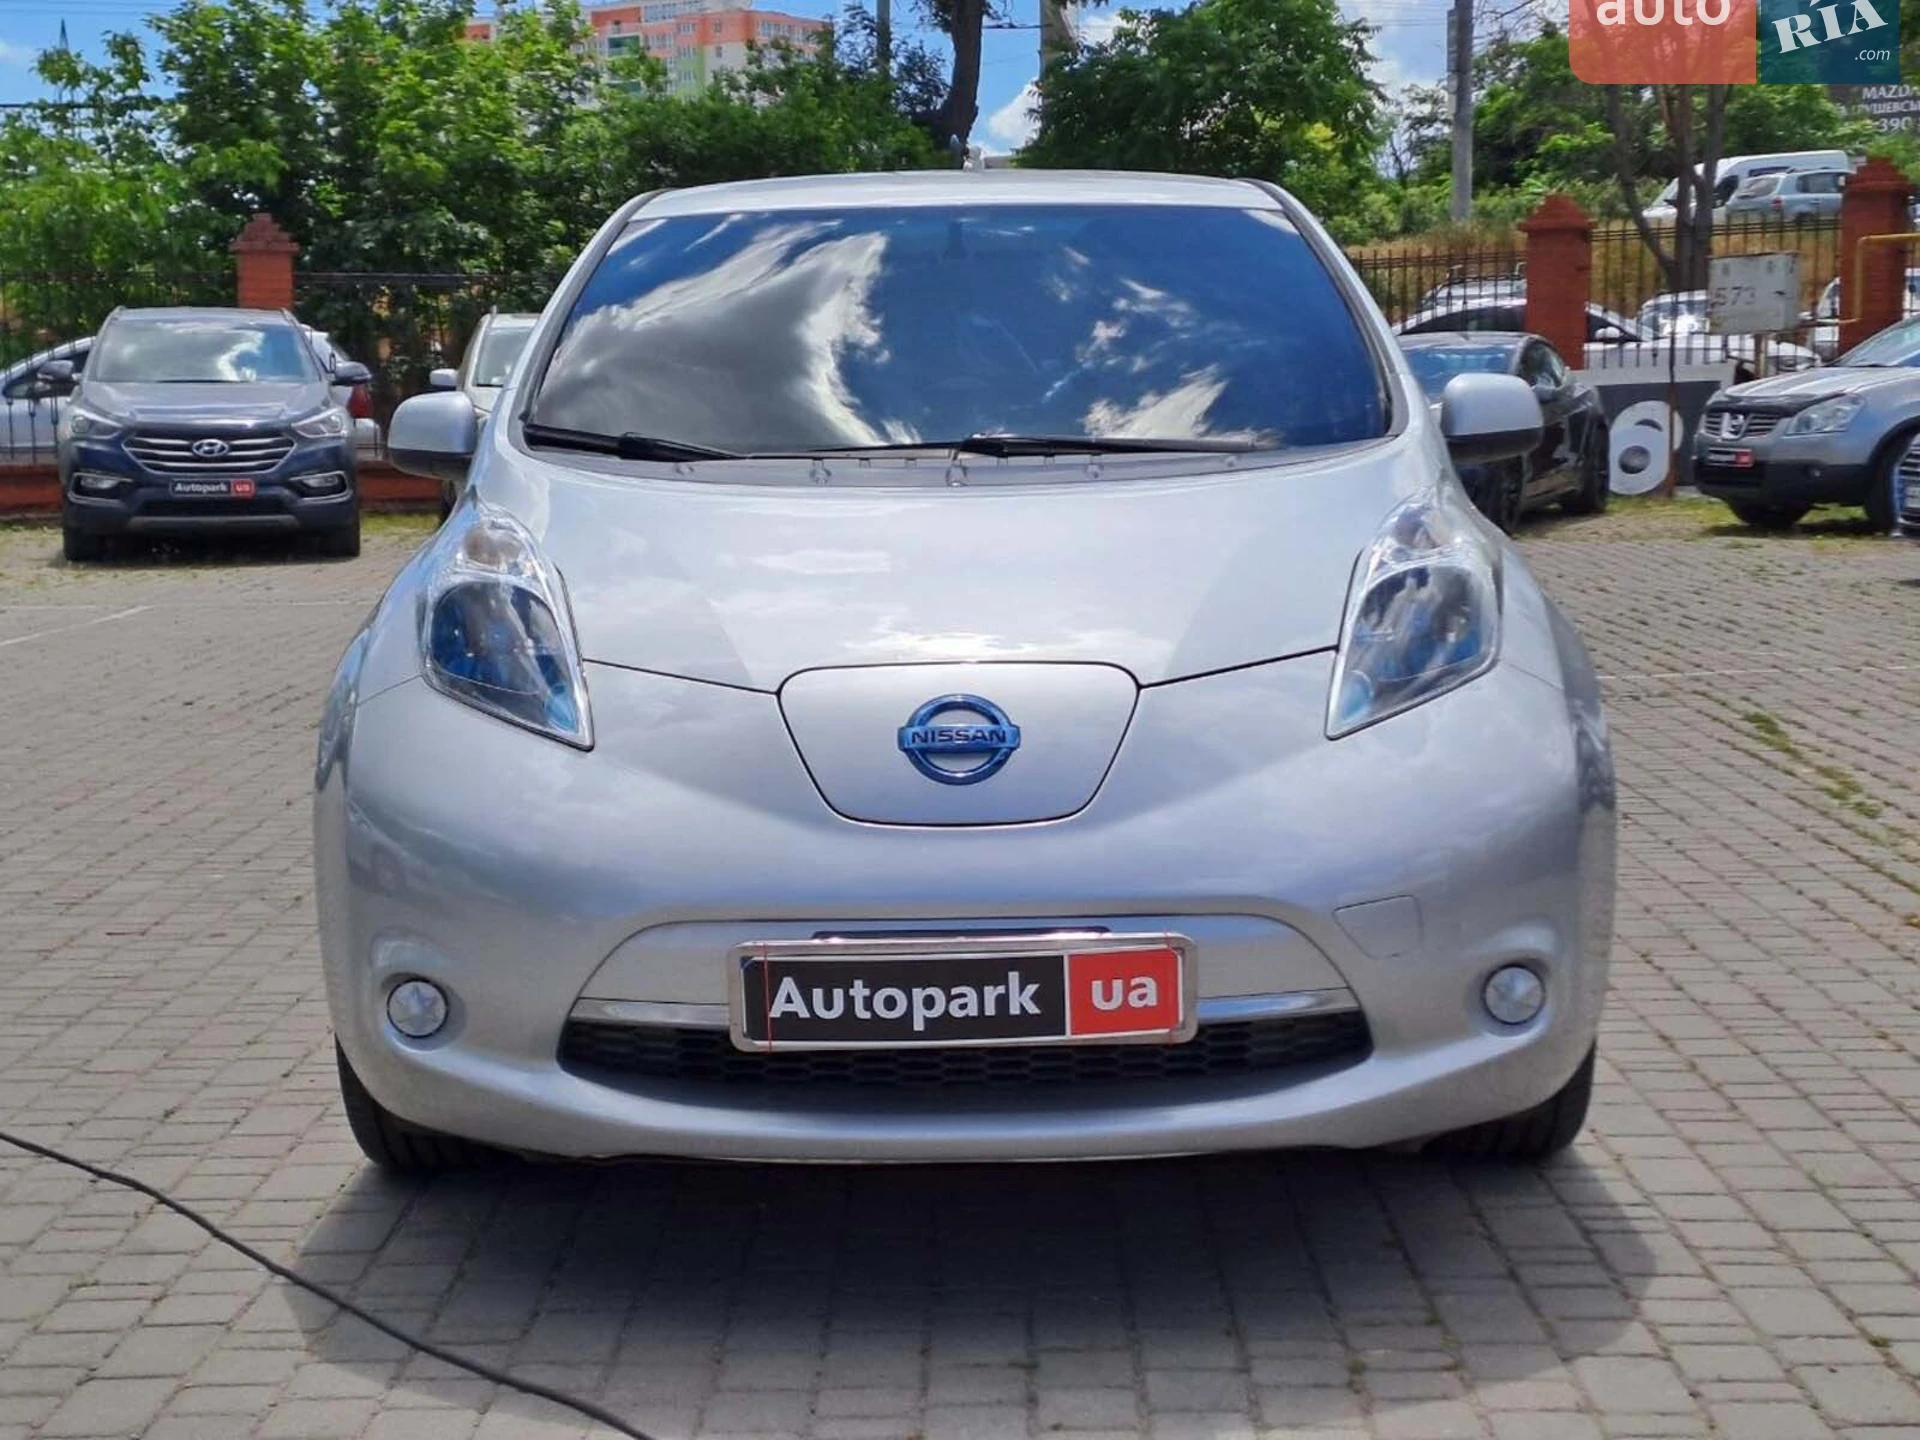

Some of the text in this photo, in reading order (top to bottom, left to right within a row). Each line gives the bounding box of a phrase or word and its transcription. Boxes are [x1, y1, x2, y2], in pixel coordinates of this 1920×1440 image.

[1862, 84, 1914, 100] MAZD
[174, 482, 228, 494] Autopark
[911, 729, 1007, 744] NISSAN
[768, 970, 1158, 1032] Autopark ua
